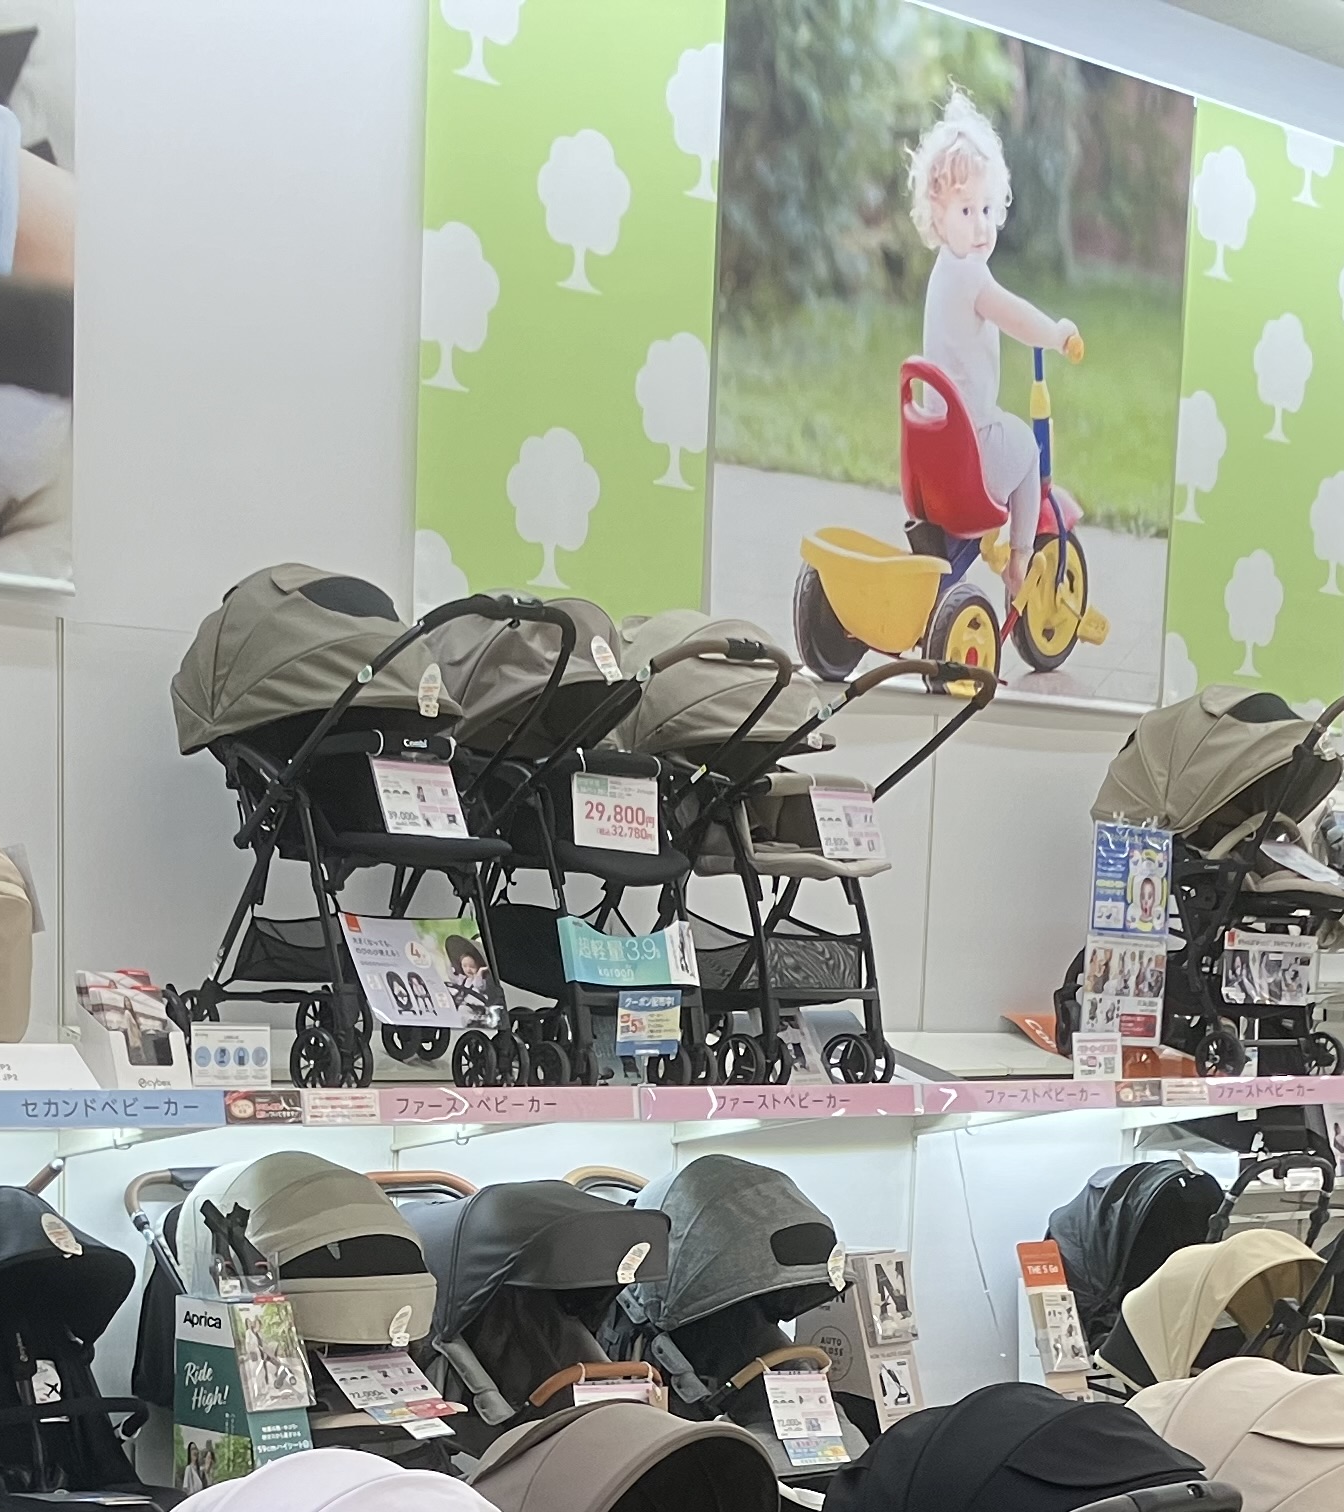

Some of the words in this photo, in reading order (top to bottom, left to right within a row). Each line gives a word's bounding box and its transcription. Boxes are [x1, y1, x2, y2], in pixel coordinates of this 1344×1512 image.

[984, 1087, 1101, 1105] ファーストベビーカー
[1217, 1084, 1316, 1099] ファーストベビーカー
[20, 1098, 200, 1119] セカンドベビーカー
[716, 1093, 851, 1112] ファーストベビーカー
[183, 1310, 222, 1330] Aprica
[820, 1336, 843, 1347] AUTO
[183, 1361, 214, 1387] Ride
[191, 1385, 230, 1414] High!
